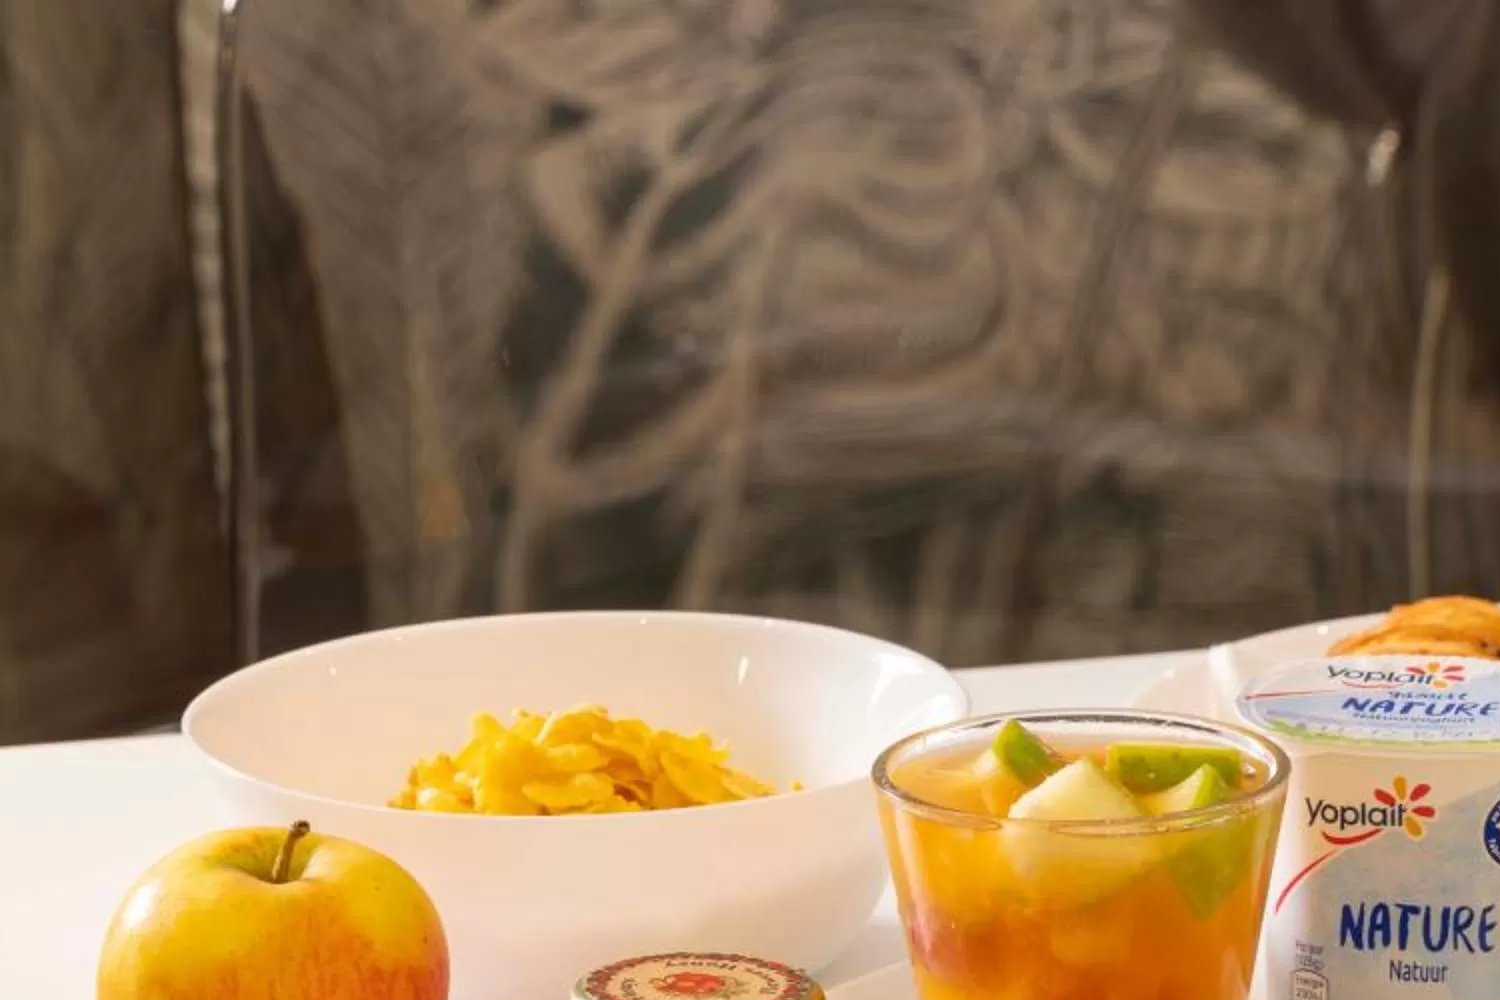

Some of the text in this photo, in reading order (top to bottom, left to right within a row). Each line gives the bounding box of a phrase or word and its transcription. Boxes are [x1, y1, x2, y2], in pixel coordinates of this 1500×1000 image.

[1327, 664, 1434, 685] Yoplait
[1341, 697, 1500, 717] NATURE
[1305, 797, 1406, 831] Yoplait
[1339, 902, 1498, 954] NATURE
[1389, 959, 1448, 984] Natuur
